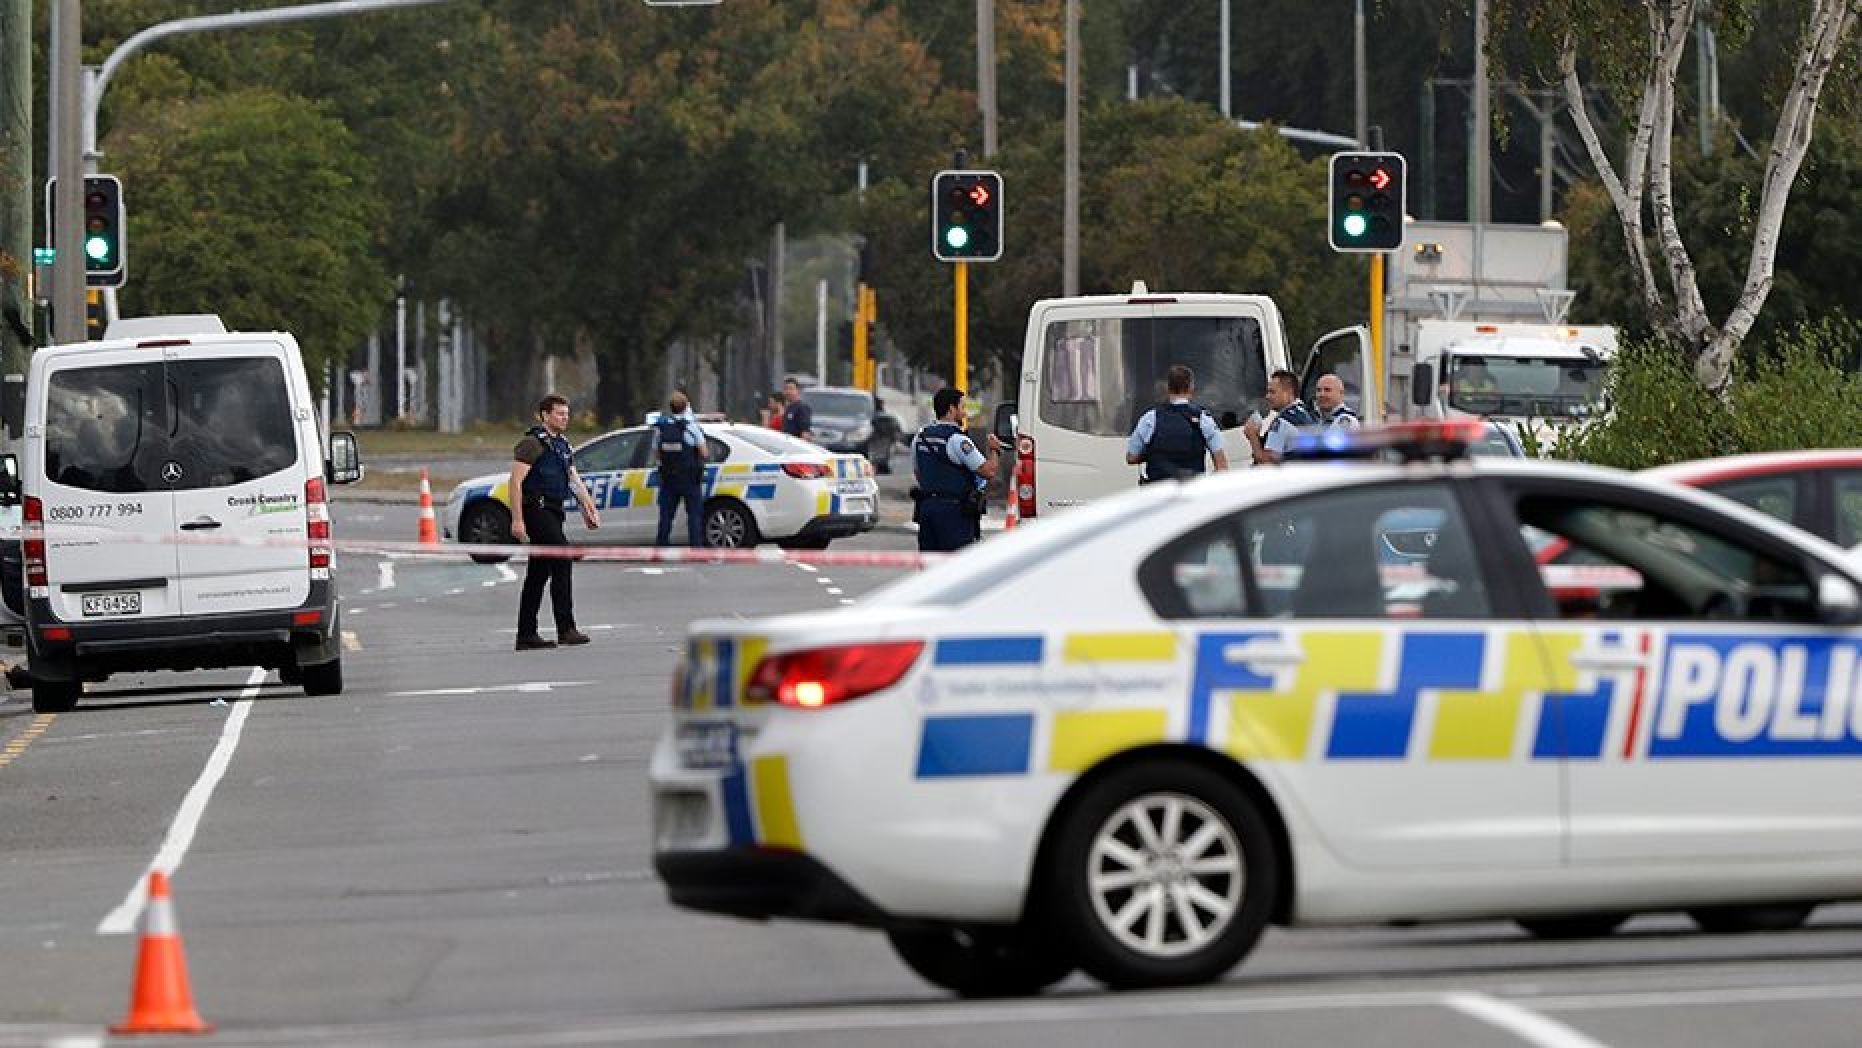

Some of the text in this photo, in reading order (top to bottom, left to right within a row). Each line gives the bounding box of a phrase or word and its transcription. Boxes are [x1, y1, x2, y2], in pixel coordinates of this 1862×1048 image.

[49, 502, 143, 521] 0800 777 994
[1656, 644, 1862, 741] POLI
